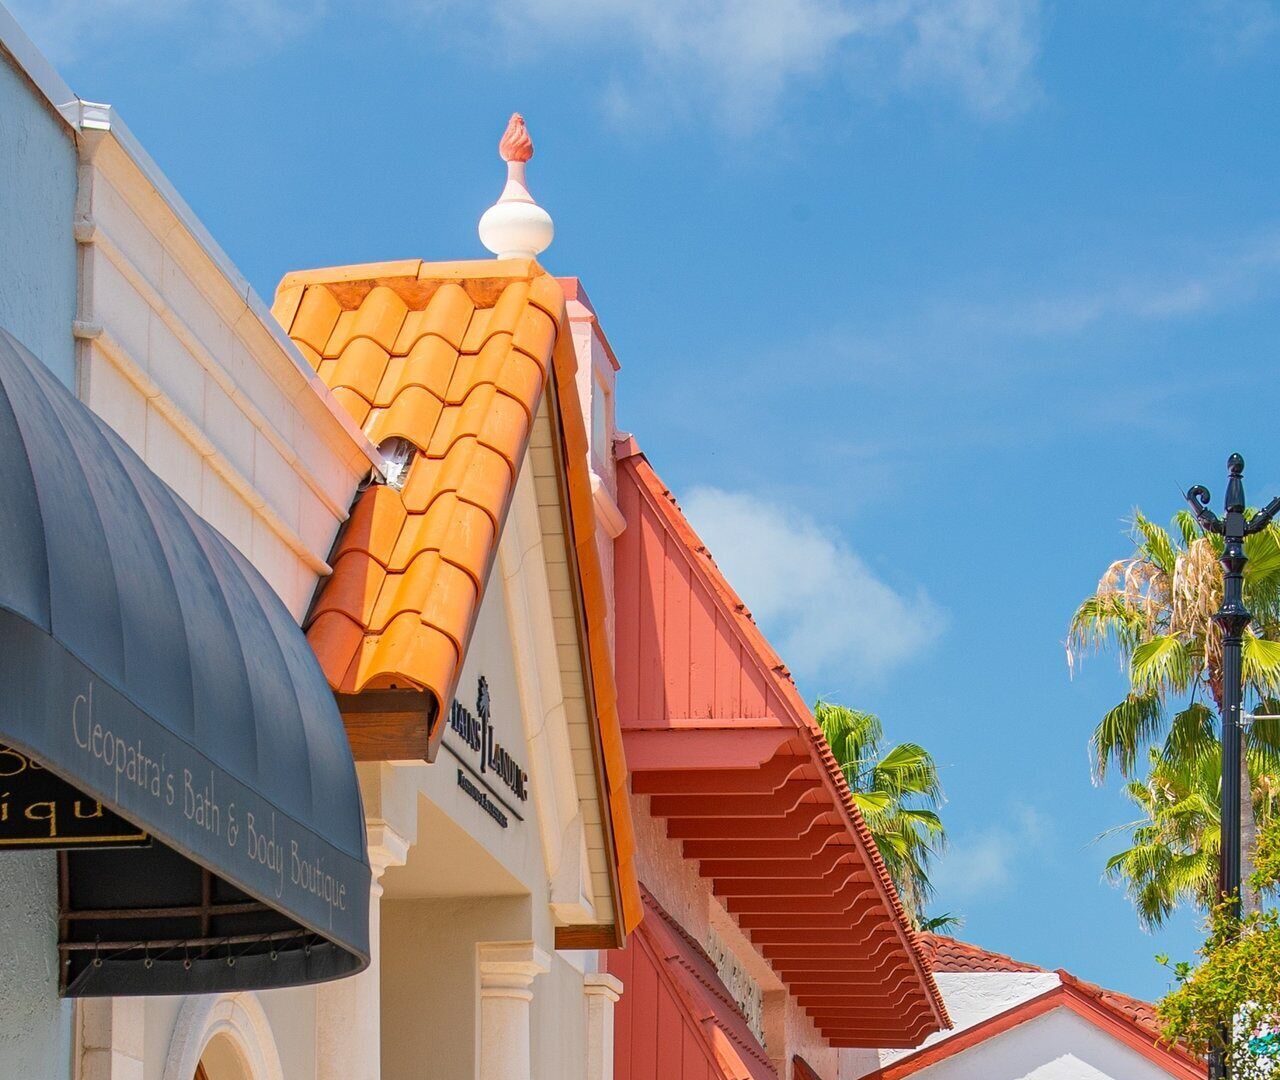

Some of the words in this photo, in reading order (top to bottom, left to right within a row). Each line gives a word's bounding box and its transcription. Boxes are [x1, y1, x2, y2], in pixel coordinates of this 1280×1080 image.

[72, 681, 175, 805] Cleopatra's
[183, 768, 220, 836] Bath
[227, 803, 239, 847] &
[247, 811, 283, 898] Body
[291, 839, 346, 930] Boutique
